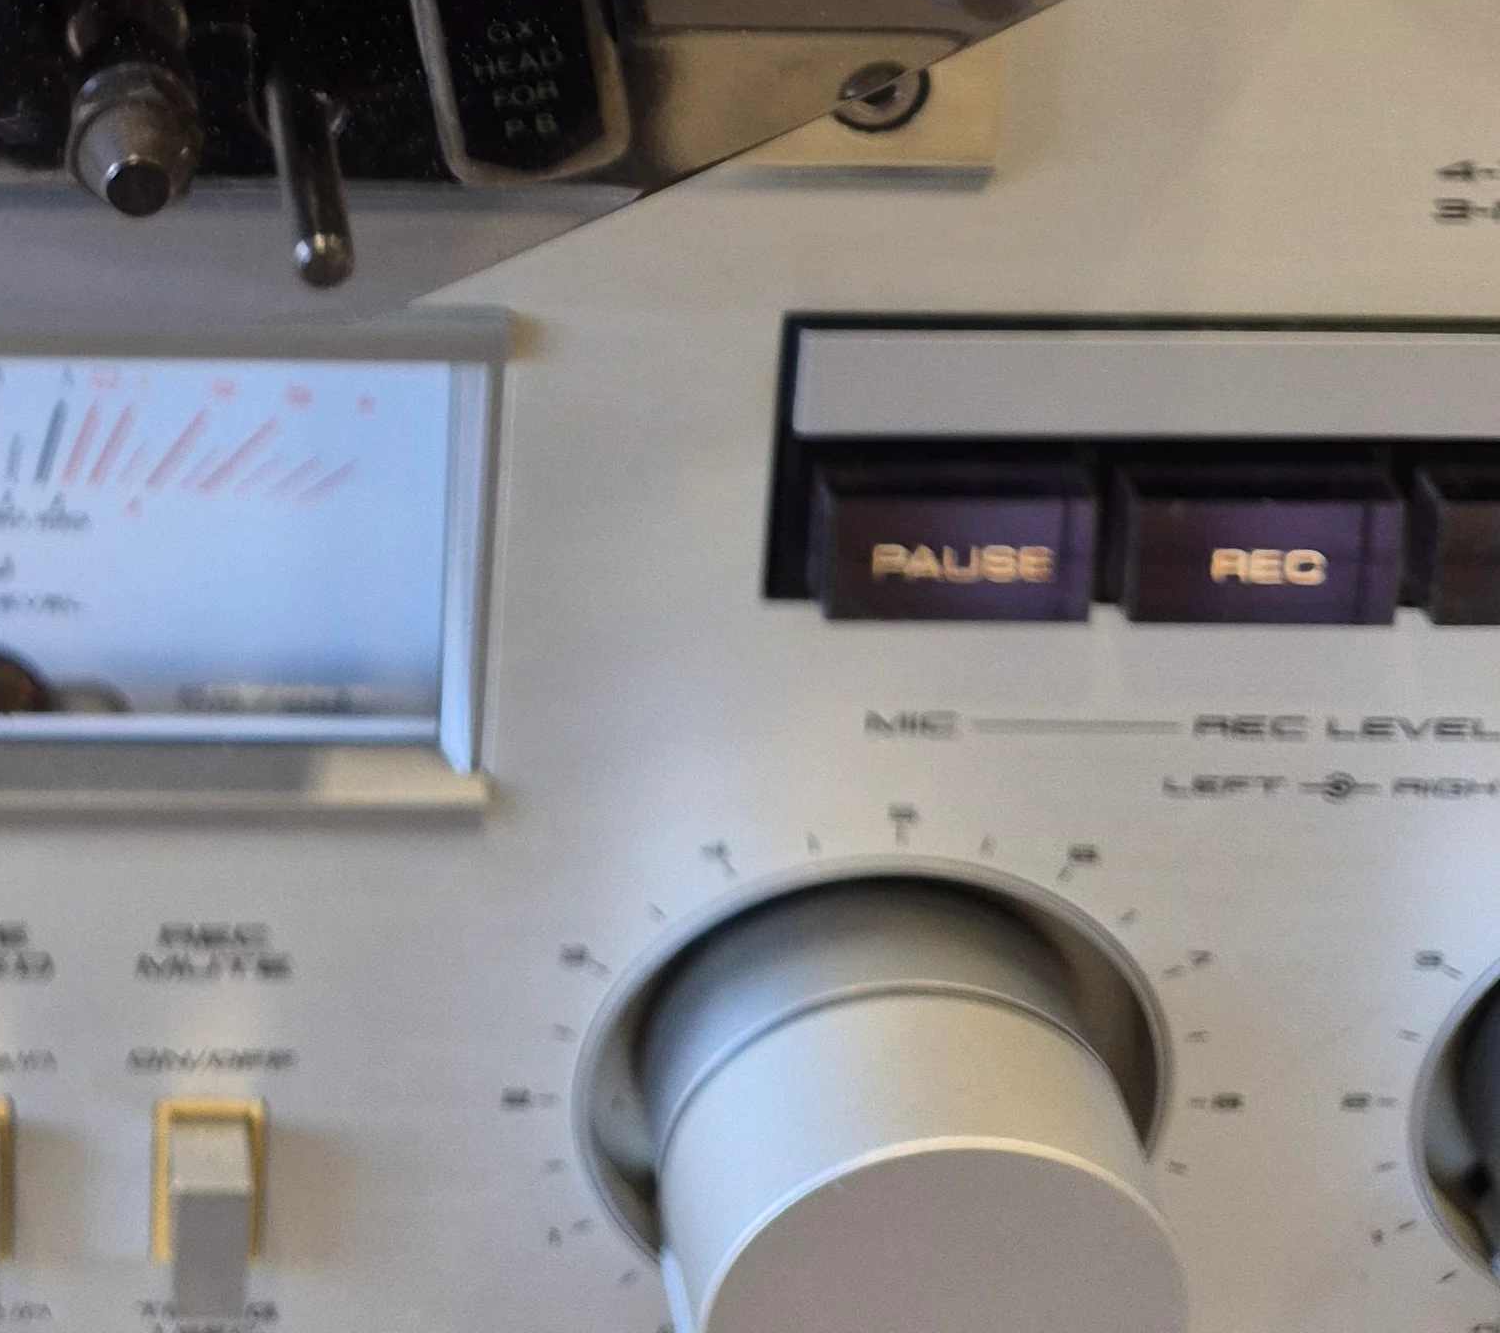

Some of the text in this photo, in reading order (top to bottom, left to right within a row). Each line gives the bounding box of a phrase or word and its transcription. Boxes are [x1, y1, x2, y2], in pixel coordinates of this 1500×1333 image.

[472, 48, 567, 84] HEAD
[492, 81, 559, 112] FOR
[871, 544, 1056, 585] PAUSE
[1210, 548, 1327, 586] REC
[864, 709, 958, 740] MIC
[1193, 714, 1500, 742] REC LEVEL
[1162, 775, 1288, 799] LEFT
[1393, 777, 1500, 800] RIGH
